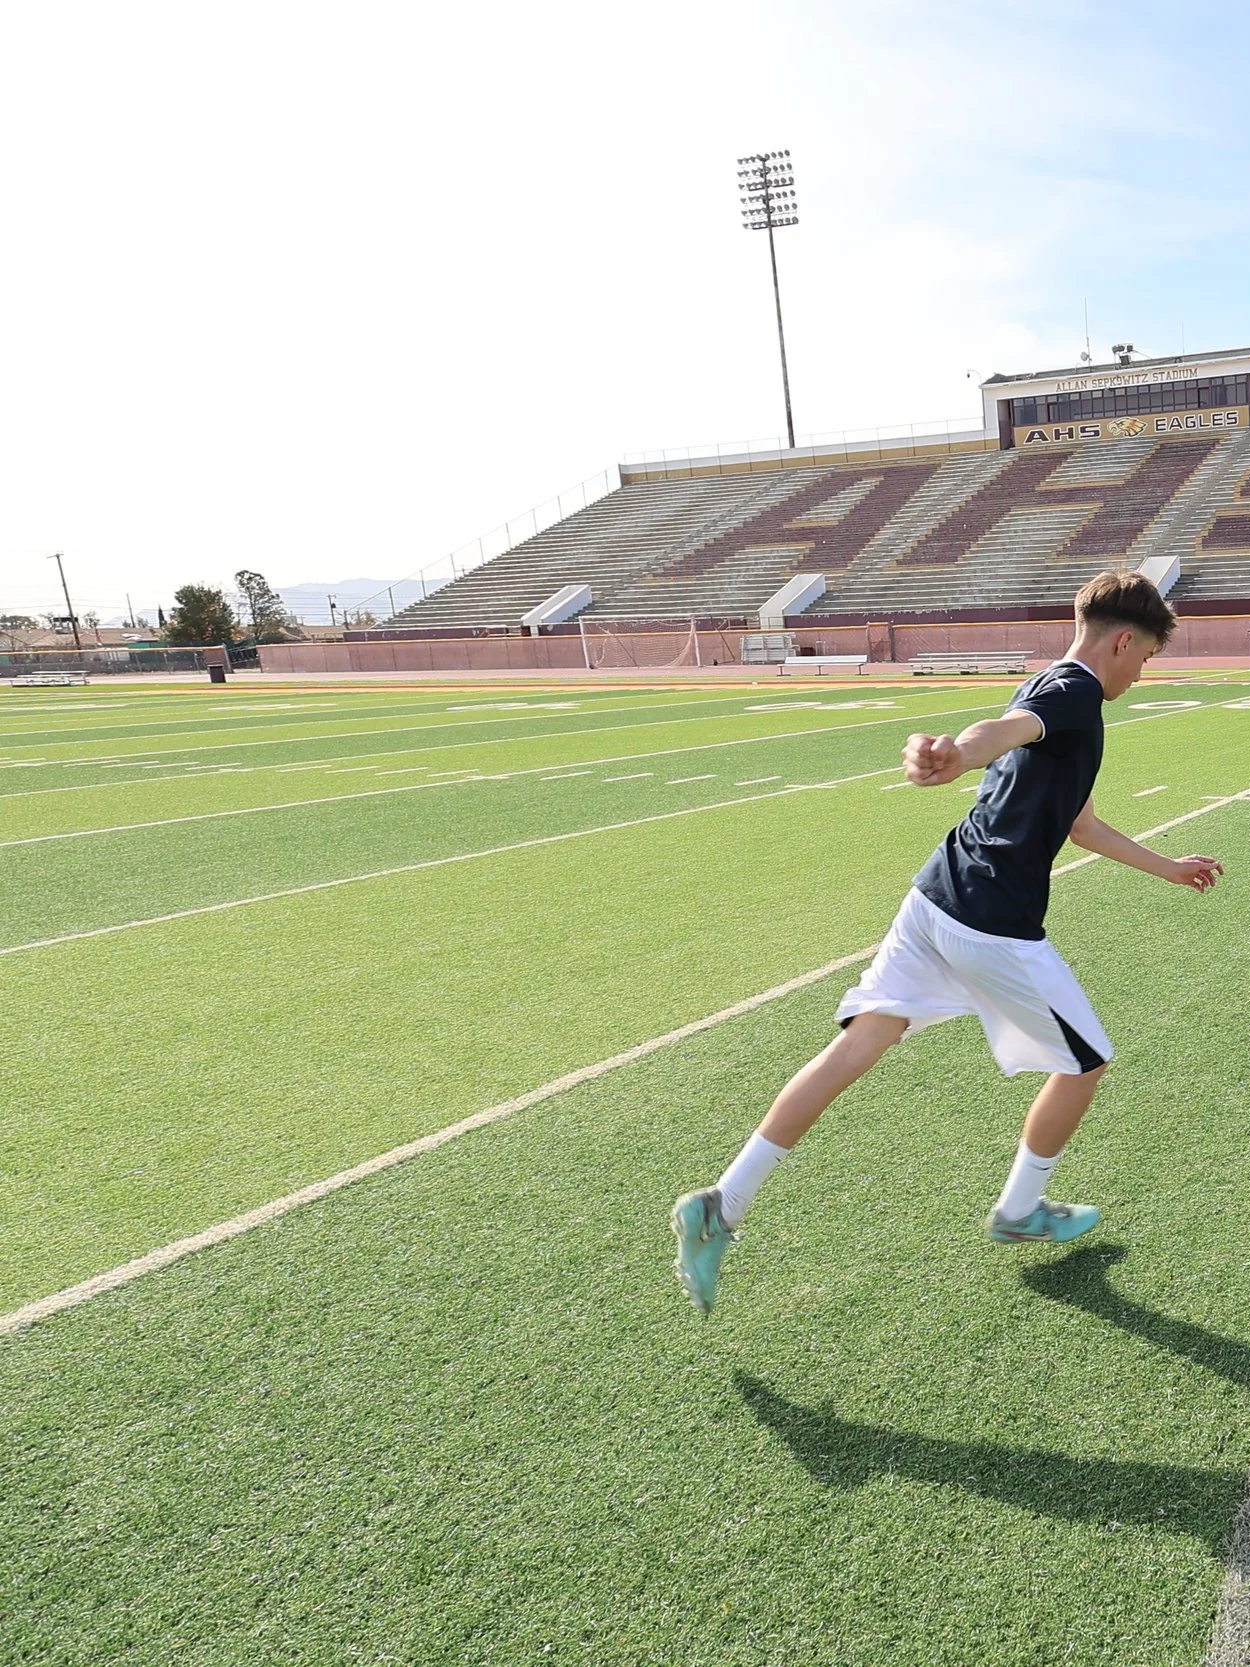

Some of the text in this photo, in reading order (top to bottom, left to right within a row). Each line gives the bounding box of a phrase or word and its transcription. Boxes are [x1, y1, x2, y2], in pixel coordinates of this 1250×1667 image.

[1056, 368, 1199, 392] ALLAN SEPKOWITZ STADIUM
[1024, 411, 1239, 444] AHS EAGLES
